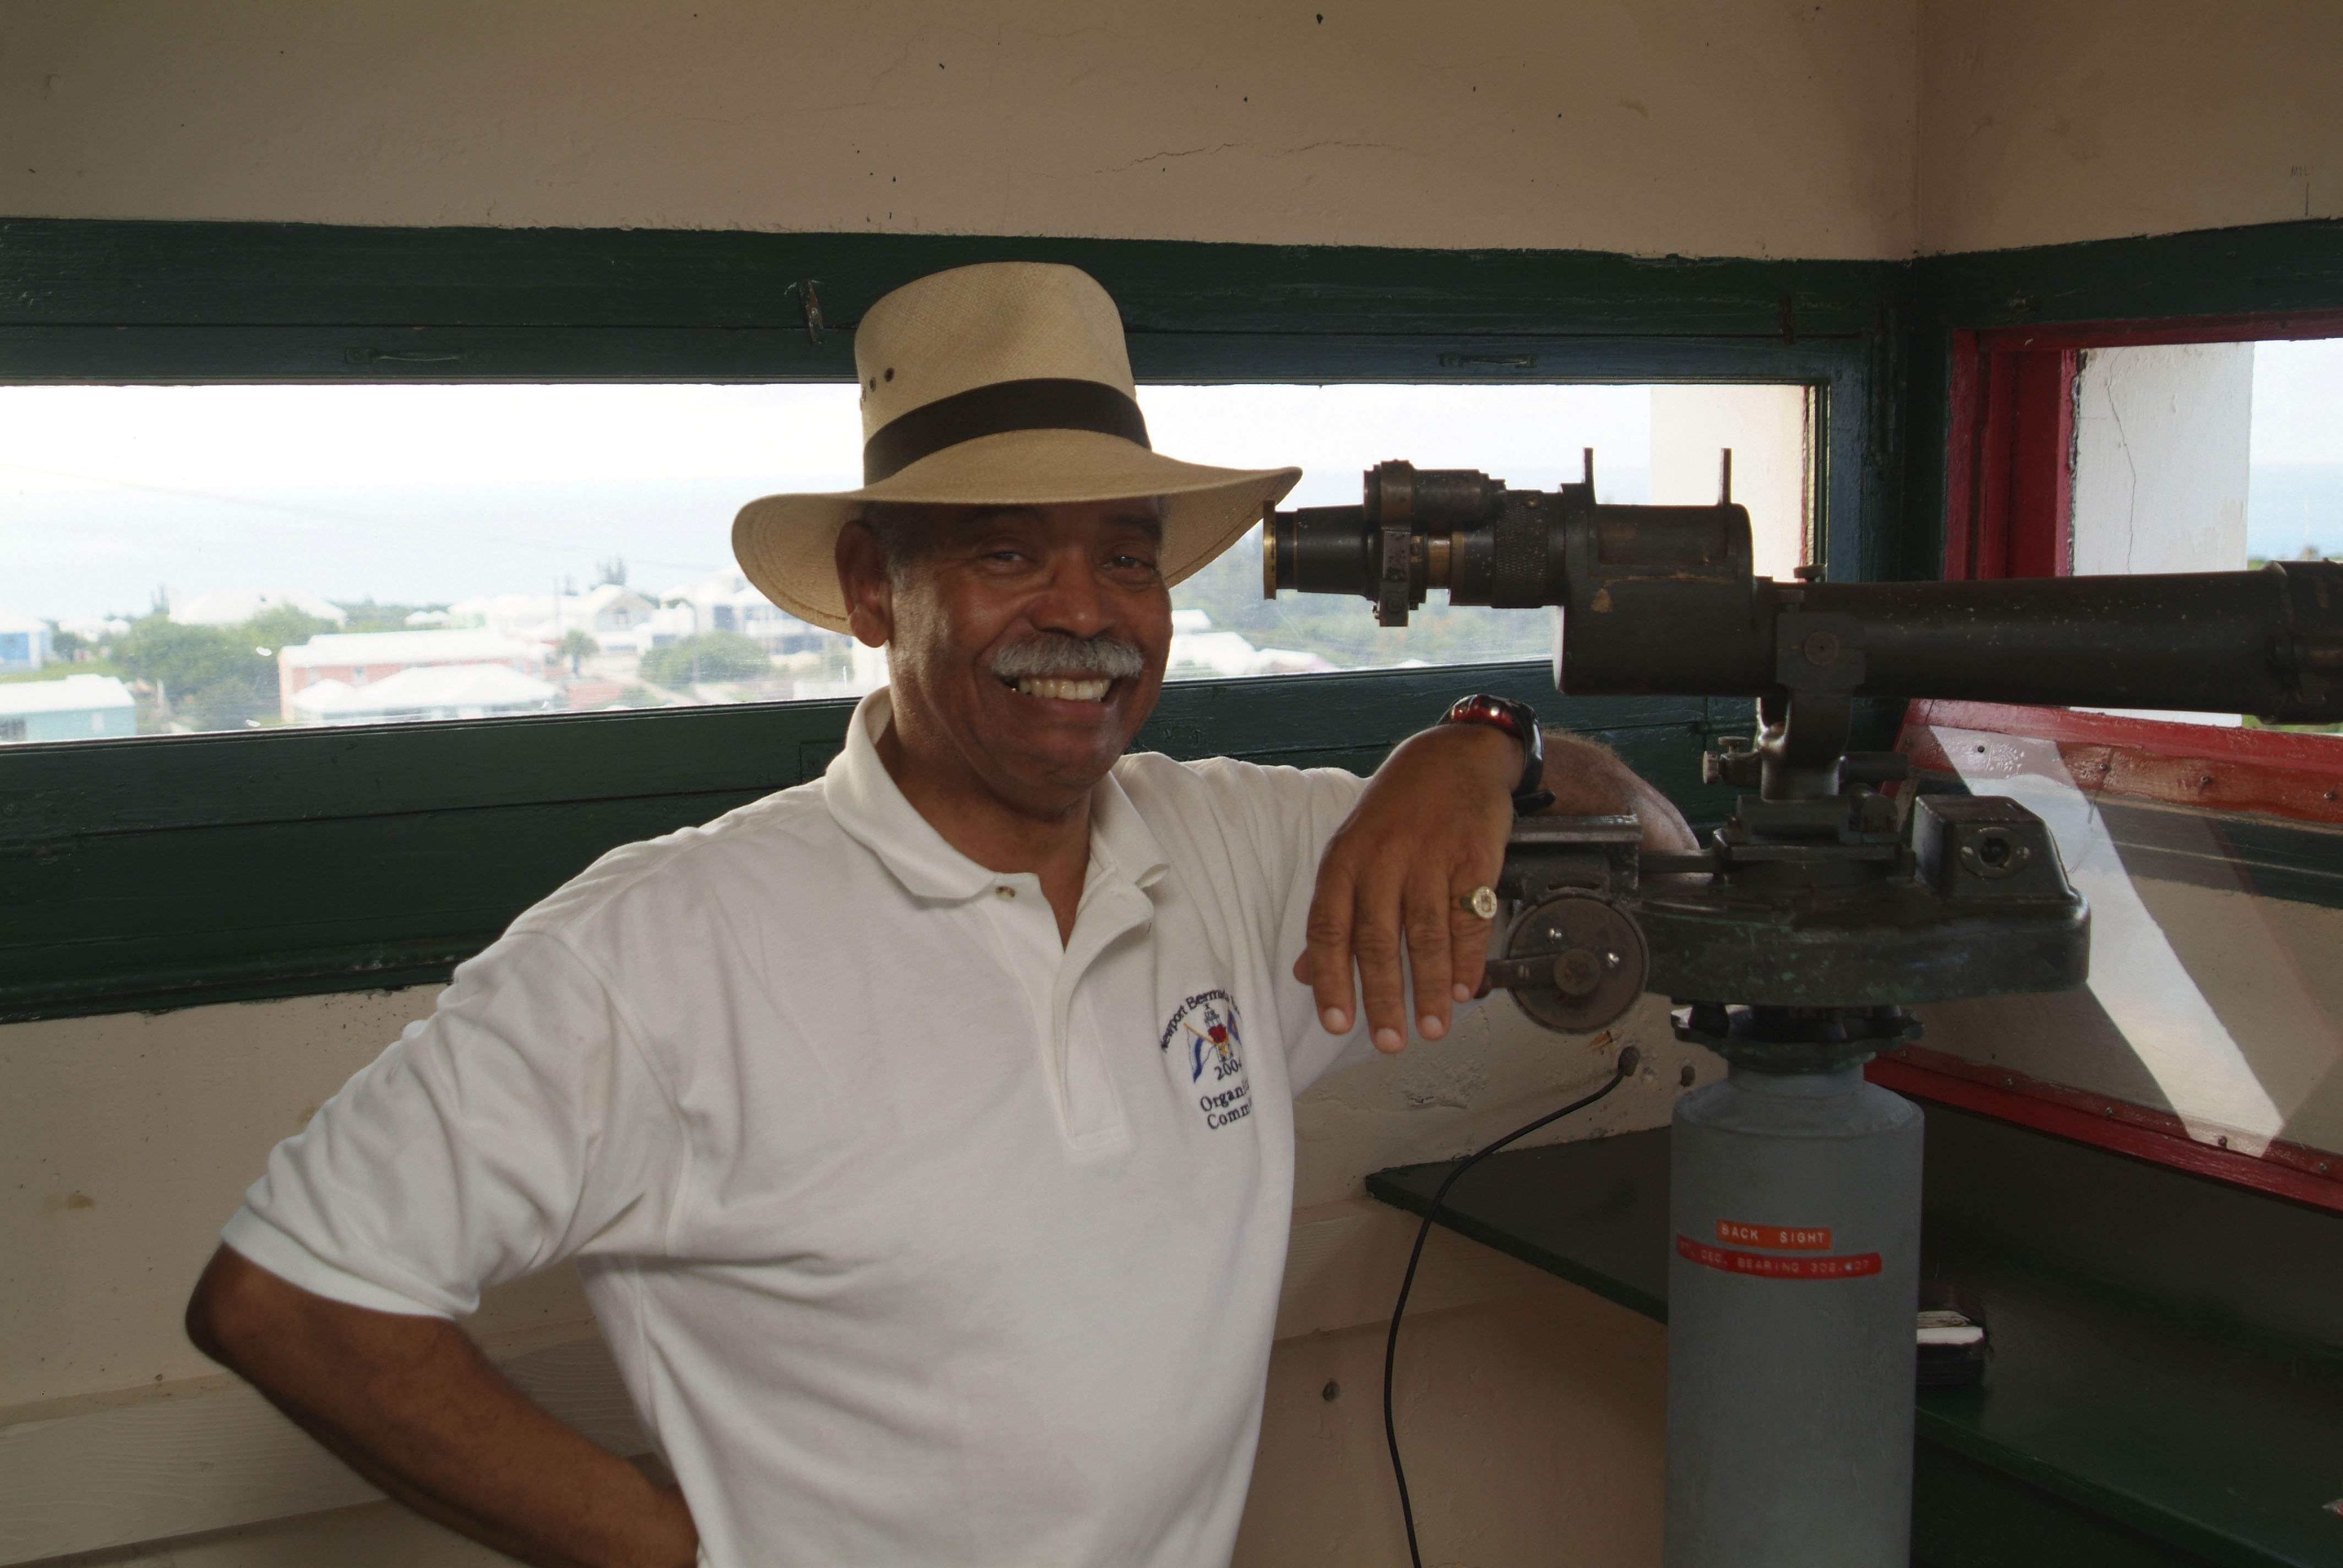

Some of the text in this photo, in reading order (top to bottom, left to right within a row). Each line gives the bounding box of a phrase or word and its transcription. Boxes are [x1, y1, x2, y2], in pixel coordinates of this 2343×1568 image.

[1721, 1223, 1824, 1244] BACK SIGHT
[1737, 1257, 1800, 1272] BEARING
